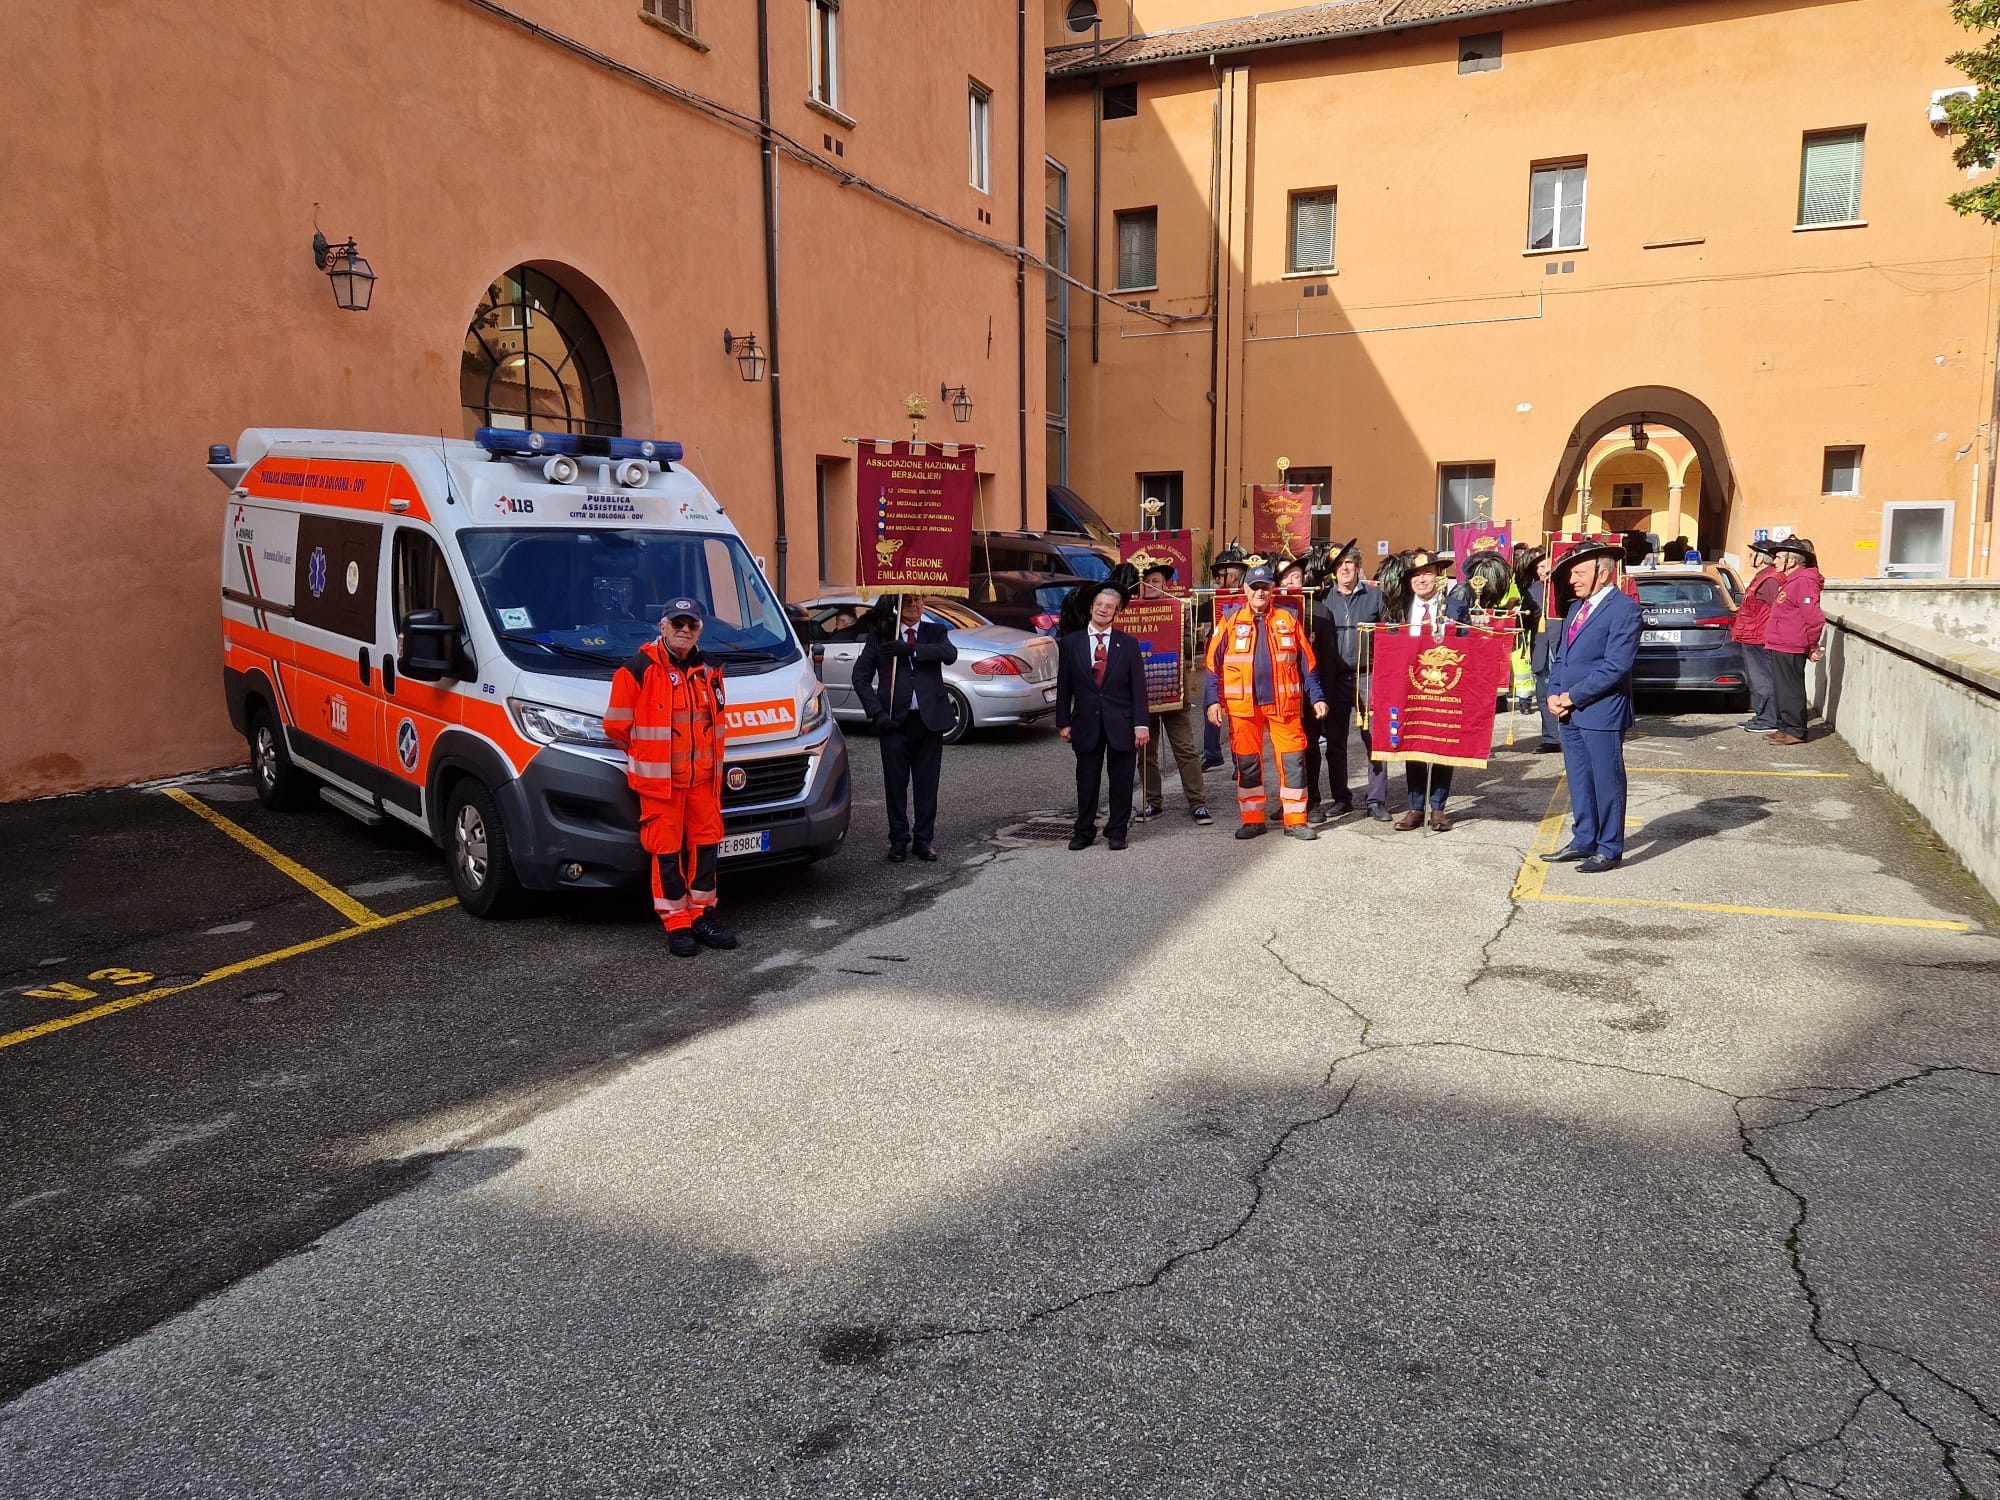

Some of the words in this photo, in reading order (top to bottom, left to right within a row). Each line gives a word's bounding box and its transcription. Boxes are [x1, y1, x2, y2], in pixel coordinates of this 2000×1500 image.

[866, 459, 922, 469] ASSOCIAZIONE
[925, 461, 967, 471] NAZIONALE
[892, 471, 941, 480] BERSAGLIERI
[587, 495, 630, 503] PUBBLICA
[512, 498, 534, 513] 118
[581, 504, 634, 512] ASSISTENZA
[597, 512, 626, 520] BOLOGNA
[906, 558, 943, 568] REGIONE
[878, 570, 904, 580] EMILIA
[906, 571, 948, 581] ROMAGNA
[1642, 607, 1696, 615] ABINIERI
[1124, 624, 1158, 633] FERRARA
[482, 683, 496, 694] 86
[331, 699, 347, 733] 118
[730, 773, 743, 785] FIAT
